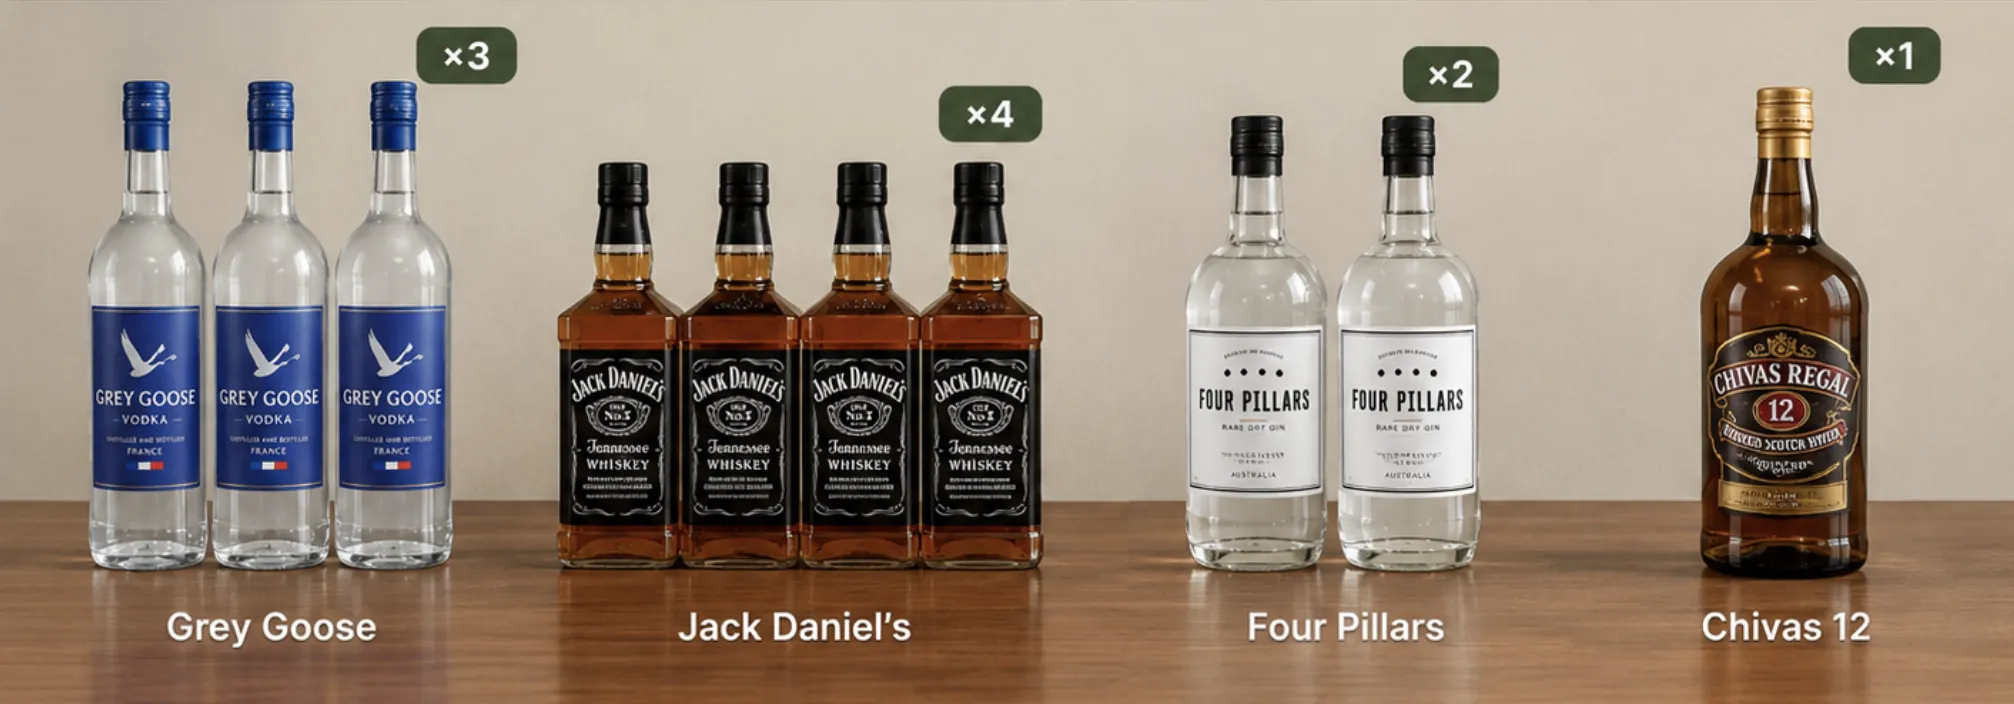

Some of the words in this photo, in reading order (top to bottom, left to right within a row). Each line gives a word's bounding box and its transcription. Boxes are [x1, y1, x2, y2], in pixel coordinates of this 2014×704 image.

[571, 371, 608, 403] JACK
[692, 371, 729, 403] JACK
[813, 371, 848, 403] JACK
[934, 371, 970, 403] JACK
[1714, 362, 1782, 395] CHIVAS
[1788, 363, 1850, 398] REGAL
[95, 389, 134, 406] GREY
[138, 388, 196, 407] GOOSE
[219, 389, 258, 406] GREY
[263, 388, 319, 407] GOOSE
[343, 389, 382, 406] GREY
[386, 388, 442, 407] GOOSE
[1199, 388, 1234, 412] FOUR
[1242, 389, 1310, 413] PILLARS
[1352, 388, 1389, 412] FOUR
[1397, 389, 1464, 413] PILLARS
[123, 414, 168, 425] VODKA
[246, 414, 292, 425] VODKA
[369, 414, 415, 425] VODKA
[1768, 398, 1795, 422] 12
[586, 458, 649, 471] WHISKEY
[707, 458, 771, 471] WHISKEY
[827, 458, 891, 471] WHISKEY
[948, 458, 1013, 471] WHISKEY
